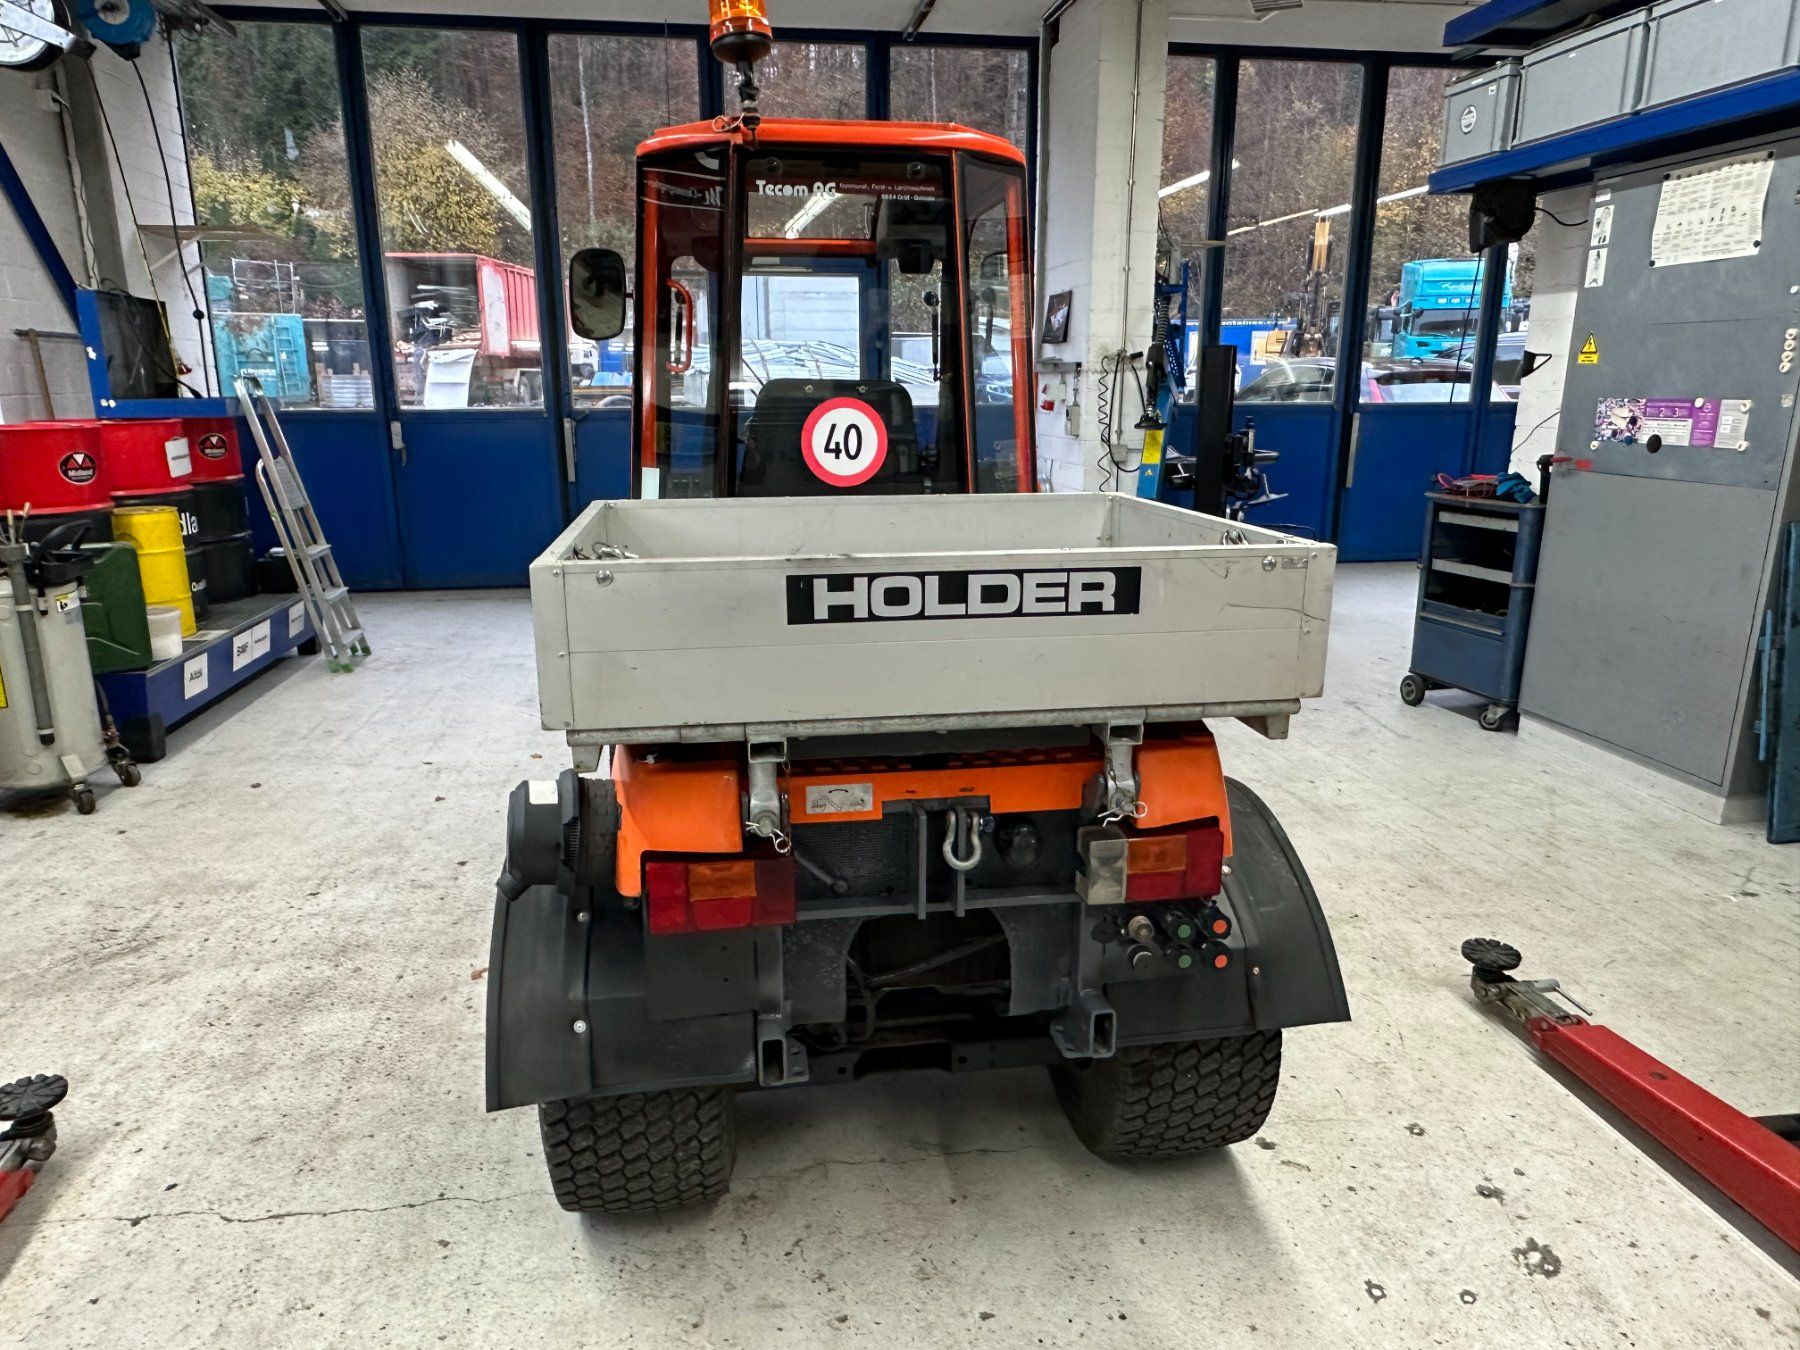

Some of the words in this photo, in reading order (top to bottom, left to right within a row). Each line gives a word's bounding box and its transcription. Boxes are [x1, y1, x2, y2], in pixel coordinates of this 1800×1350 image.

[756, 180, 808, 197] Tecom
[813, 181, 836, 197] AG
[824, 423, 862, 460] 40
[813, 571, 1116, 620] HOLDER
